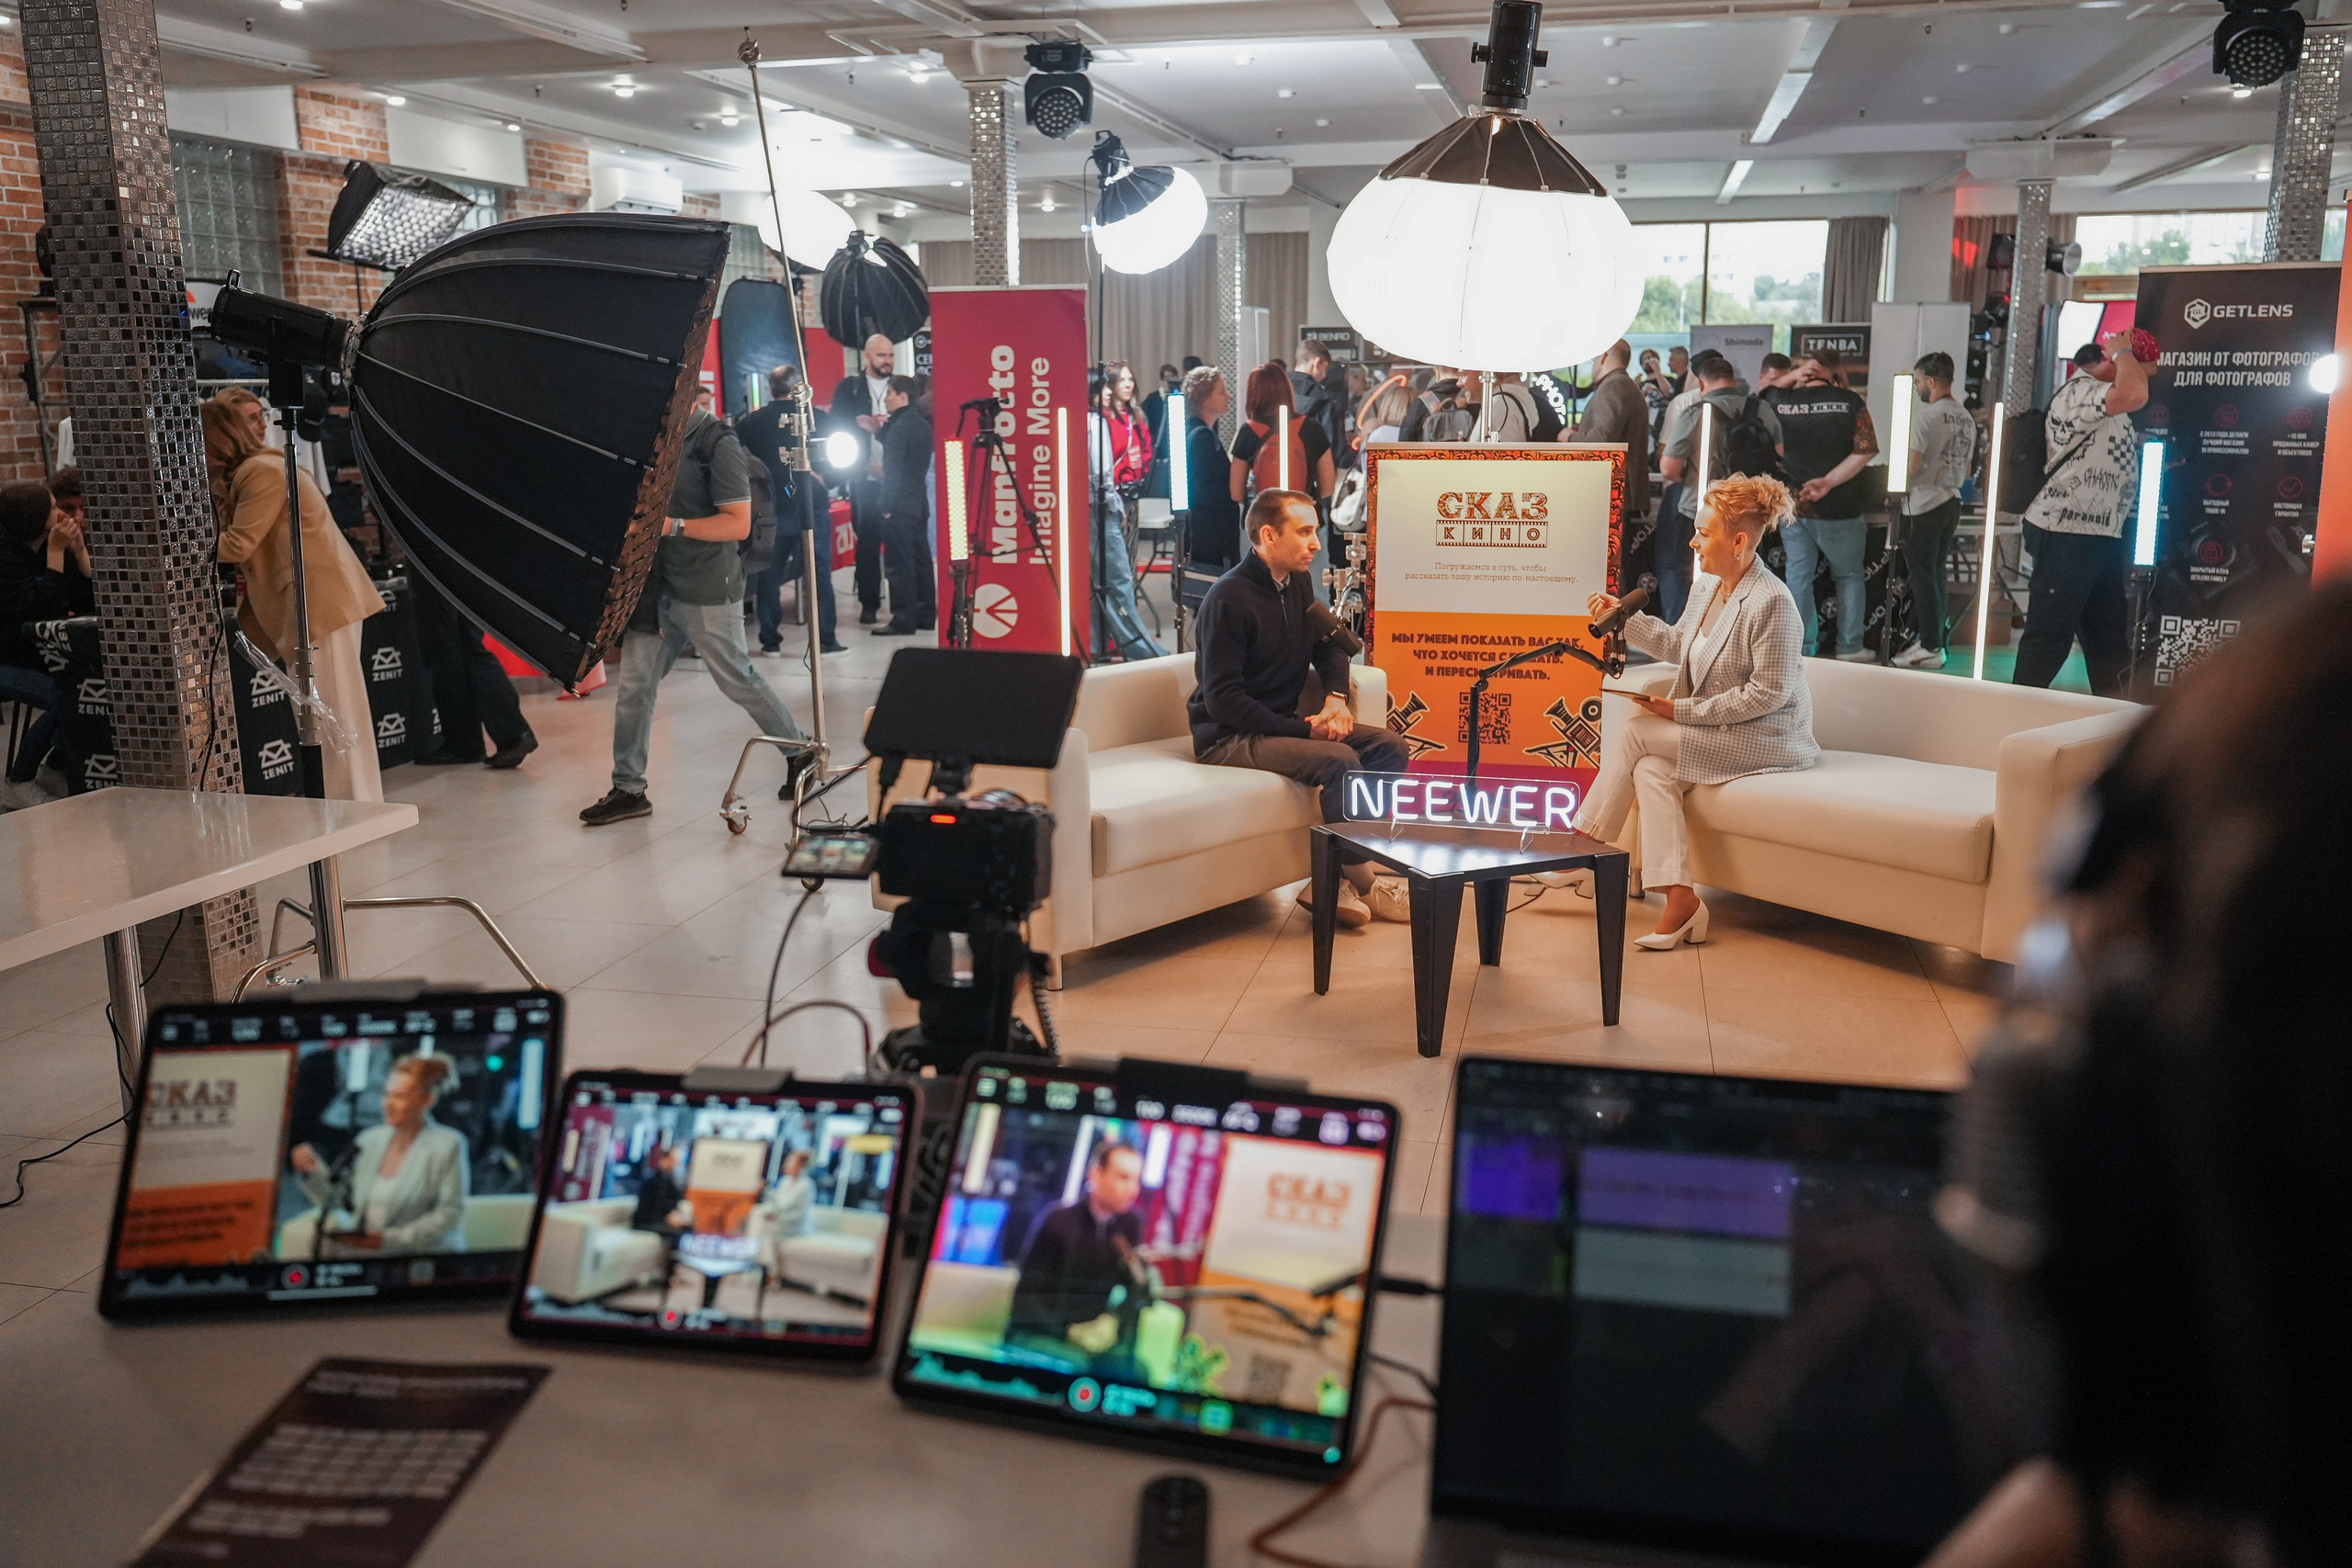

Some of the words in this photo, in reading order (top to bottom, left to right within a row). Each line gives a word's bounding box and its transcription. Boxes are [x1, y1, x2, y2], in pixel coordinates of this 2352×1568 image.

[2213, 304, 2293, 318] GETLENS
[2214, 352, 2230, 367] ОТ
[2174, 371, 2203, 387] ДЛЯ
[2205, 371, 2291, 387] ФОТОГРАФОВ
[1026, 356, 1051, 435] More
[1437, 491, 1548, 520] СКАЗ
[2057, 506, 2112, 527] paranoid
[1443, 527, 1541, 541] КИНО
[1435, 562, 1490, 571] Погружаемся
[1521, 564, 1546, 572] чтобы
[1525, 575, 1578, 583] настоящему.
[1391, 633, 1414, 643] МЫ
[1416, 633, 1458, 645] УМЕЕМ
[1461, 635, 1526, 647] ПОКАЗАТЬ
[1529, 637, 1554, 647] ВАС
[1413, 649, 1438, 660] ЧТО
[1441, 650, 1497, 661] ХОЧЕТСЯ
[372, 668, 403, 682] ZENIT
[1425, 667, 1434, 676] И
[1436, 666, 1551, 680] ПЕРЕСМТРИВАТЬ.
[252, 691, 286, 708] ZENIT
[77, 704, 109, 716] ZENI
[378, 734, 407, 749] ZENIT
[262, 761, 295, 781] ZENIT
[1351, 777, 1576, 829] NEEWER
